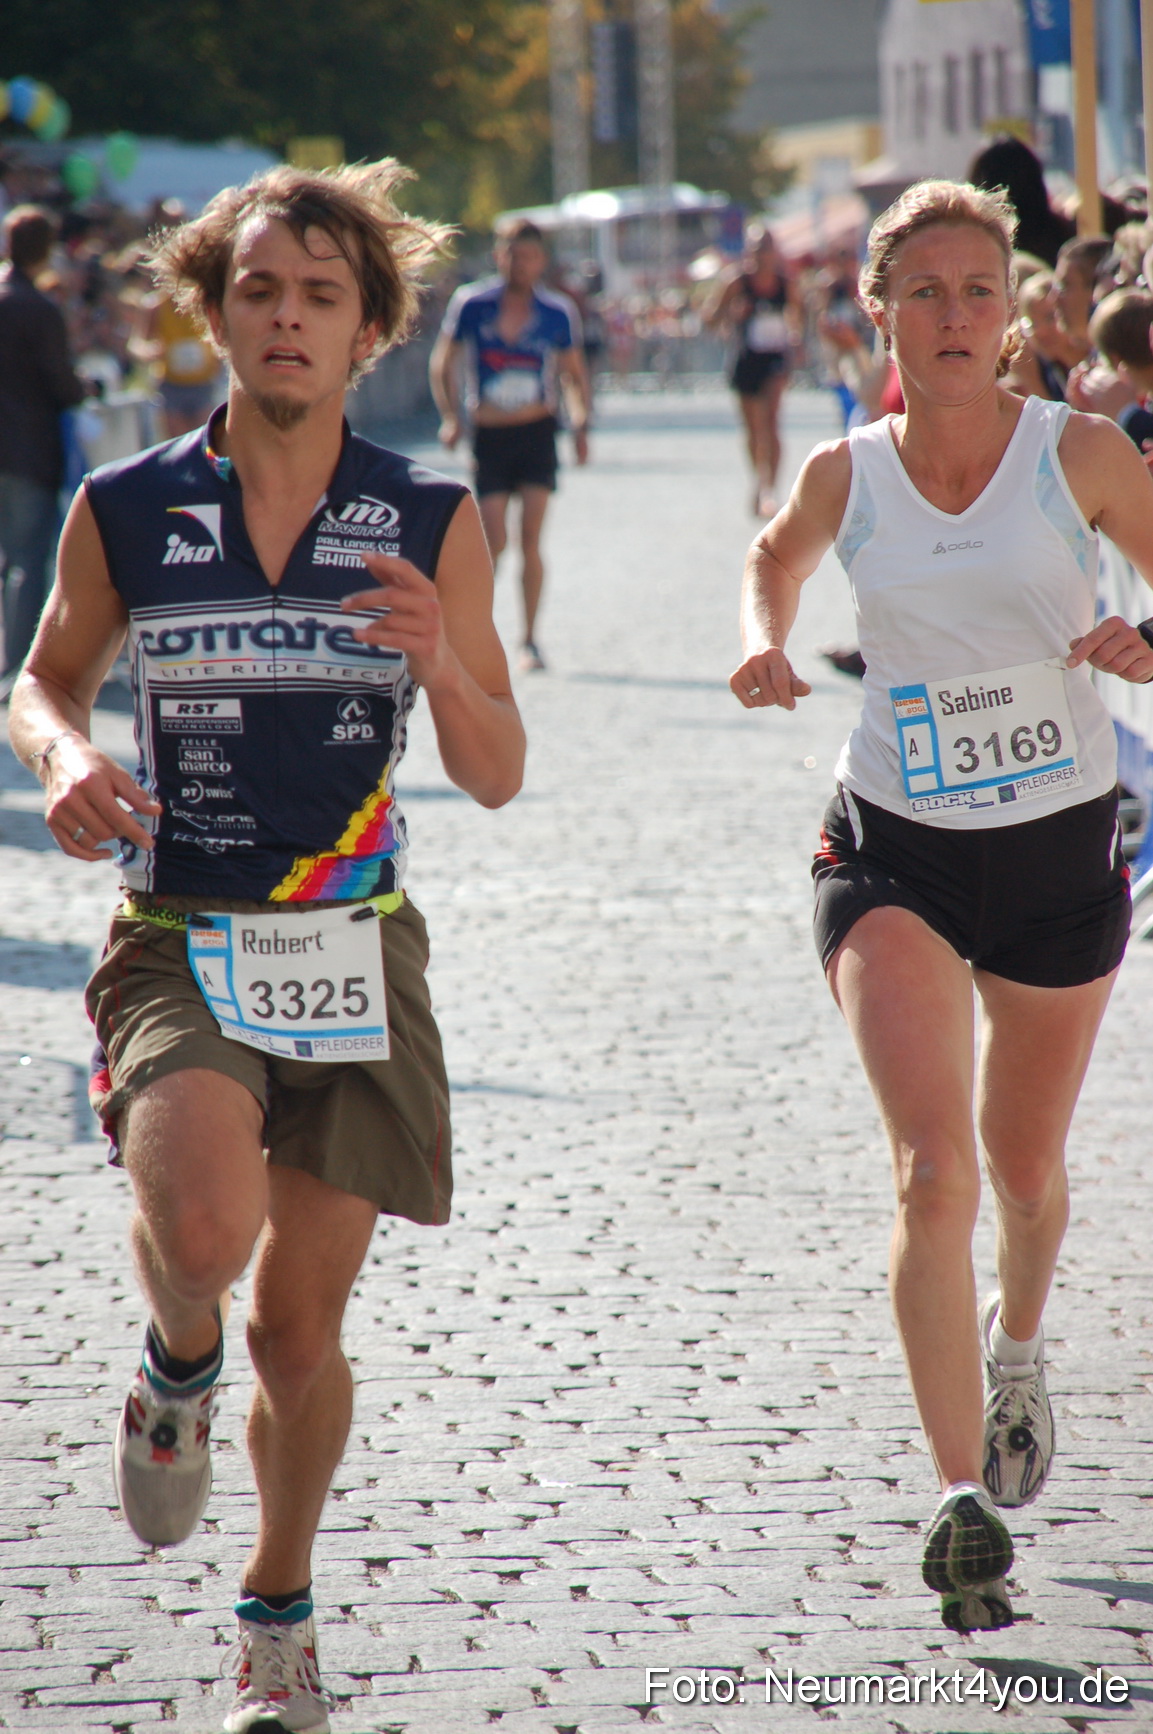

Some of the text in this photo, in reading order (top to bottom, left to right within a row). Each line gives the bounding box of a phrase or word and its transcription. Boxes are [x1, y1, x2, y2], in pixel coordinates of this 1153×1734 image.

[317, 520, 401, 538] MANITOU
[315, 536, 342, 548] PAUL
[343, 539, 376, 551] LANGE
[312, 551, 367, 569] SHIM
[231, 663, 308, 675] RIDE
[325, 665, 389, 681] TECH
[176, 703, 219, 715] RST
[937, 686, 1014, 716] Sabine
[162, 723, 240, 731] TECHNOLOGY
[332, 724, 375, 740] SPD
[180, 738, 218, 747] SELLE
[908, 737, 920, 758] A
[953, 718, 1063, 775] 3169
[183, 749, 215, 761] san
[178, 761, 232, 774] marco
[1015, 766, 1078, 793] PFLEIDERER
[181, 787, 198, 798] DT
[912, 790, 977, 813] BOCK
[240, 928, 325, 956] Robert
[202, 970, 215, 988] A
[248, 976, 370, 1021] 3325
[313, 1036, 386, 1052] PFLEIDERER
